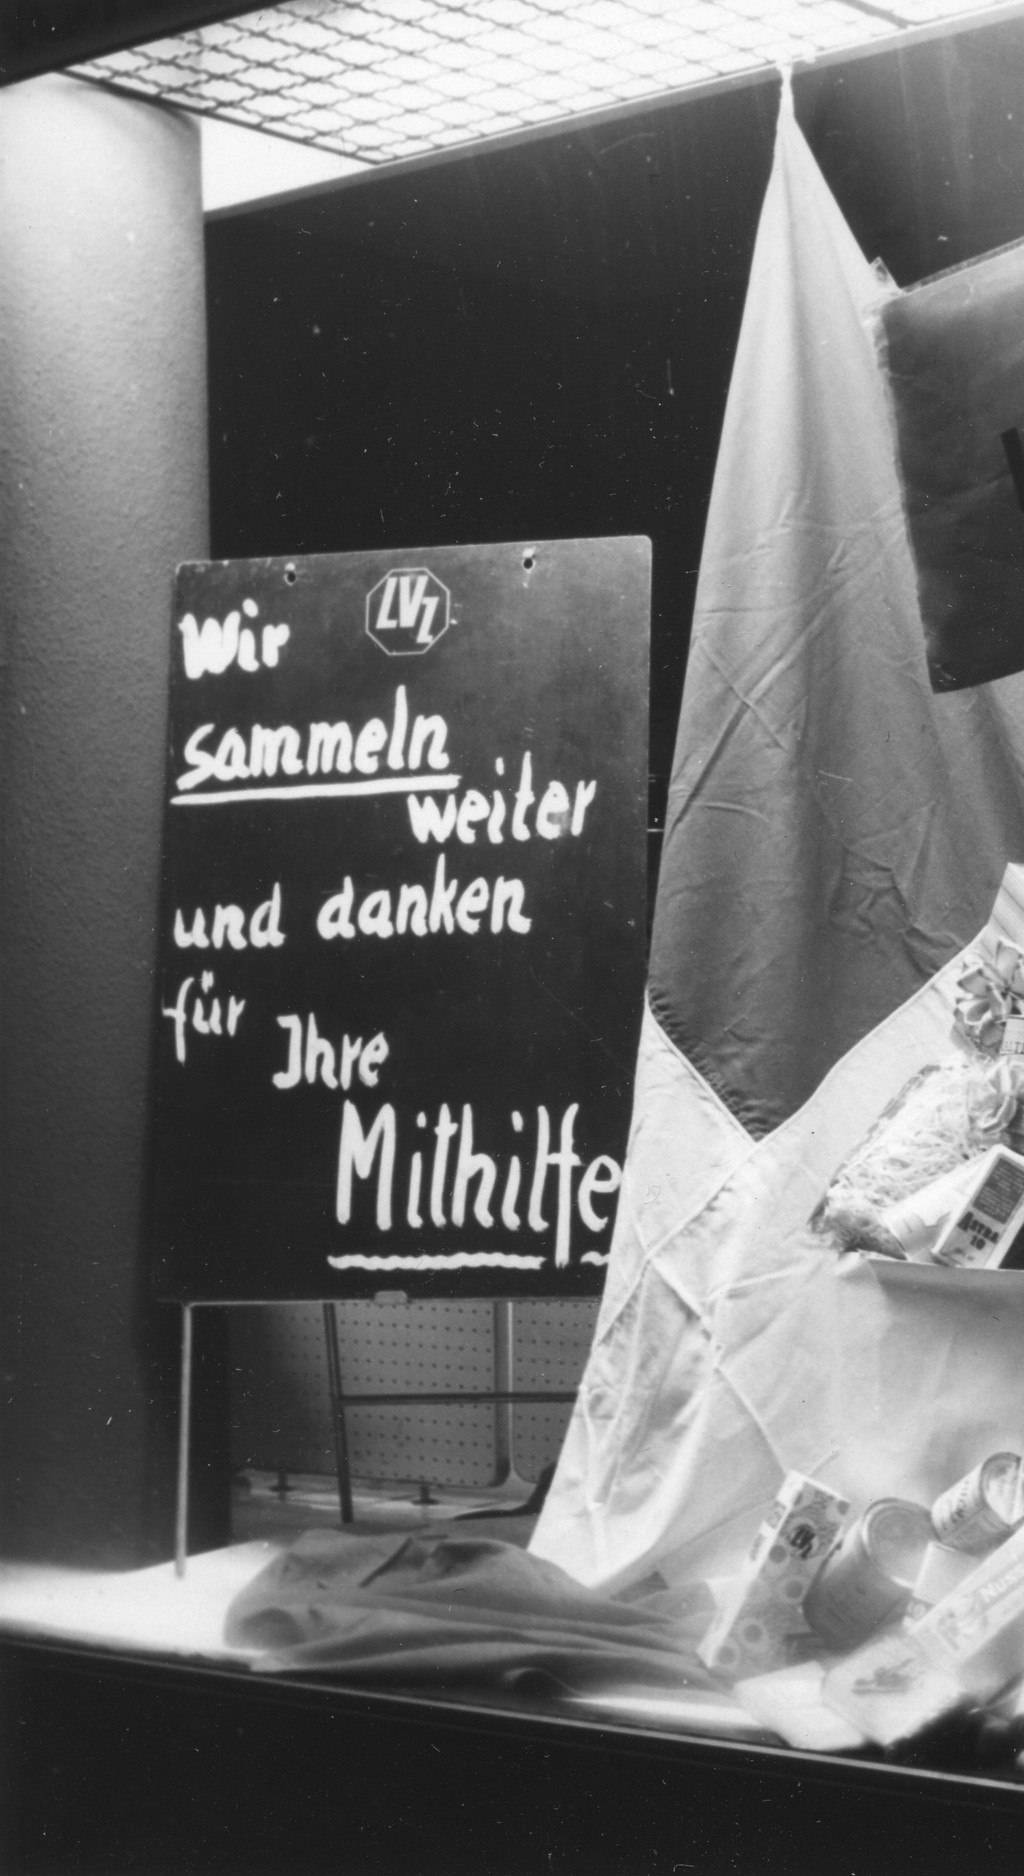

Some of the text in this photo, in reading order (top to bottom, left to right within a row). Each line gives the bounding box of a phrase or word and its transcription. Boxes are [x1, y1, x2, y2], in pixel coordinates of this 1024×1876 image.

[178, 598, 291, 680] Wir
[177, 685, 449, 791] sammeln
[407, 750, 597, 844] weiter
[174, 853, 532, 950] und danken
[162, 970, 245, 1065] für
[336, 1099, 622, 1268] Mithilfe
